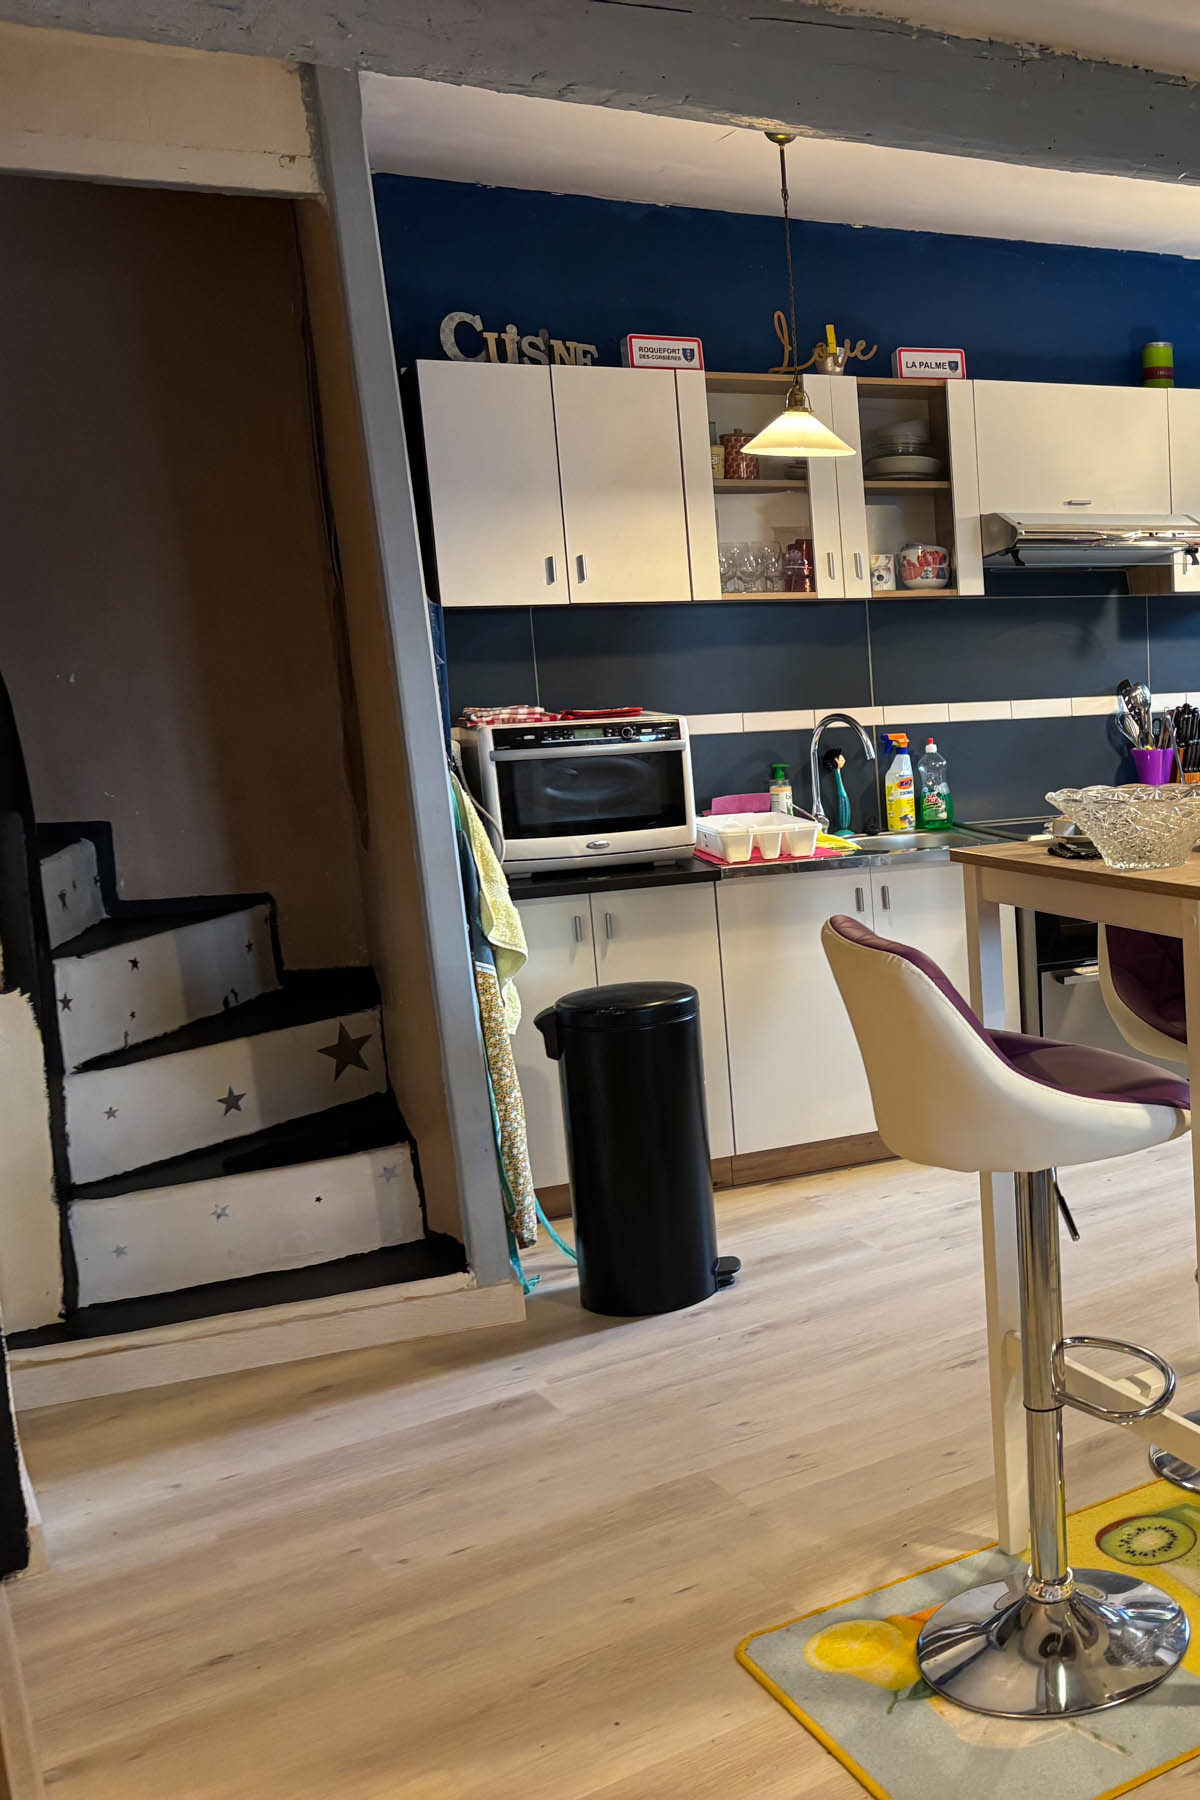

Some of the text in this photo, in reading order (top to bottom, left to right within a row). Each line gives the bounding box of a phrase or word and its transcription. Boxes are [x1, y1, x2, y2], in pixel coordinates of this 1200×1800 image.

[638, 346, 681, 355] ROQUEFORT
[905, 361, 947, 370] LA PALME
